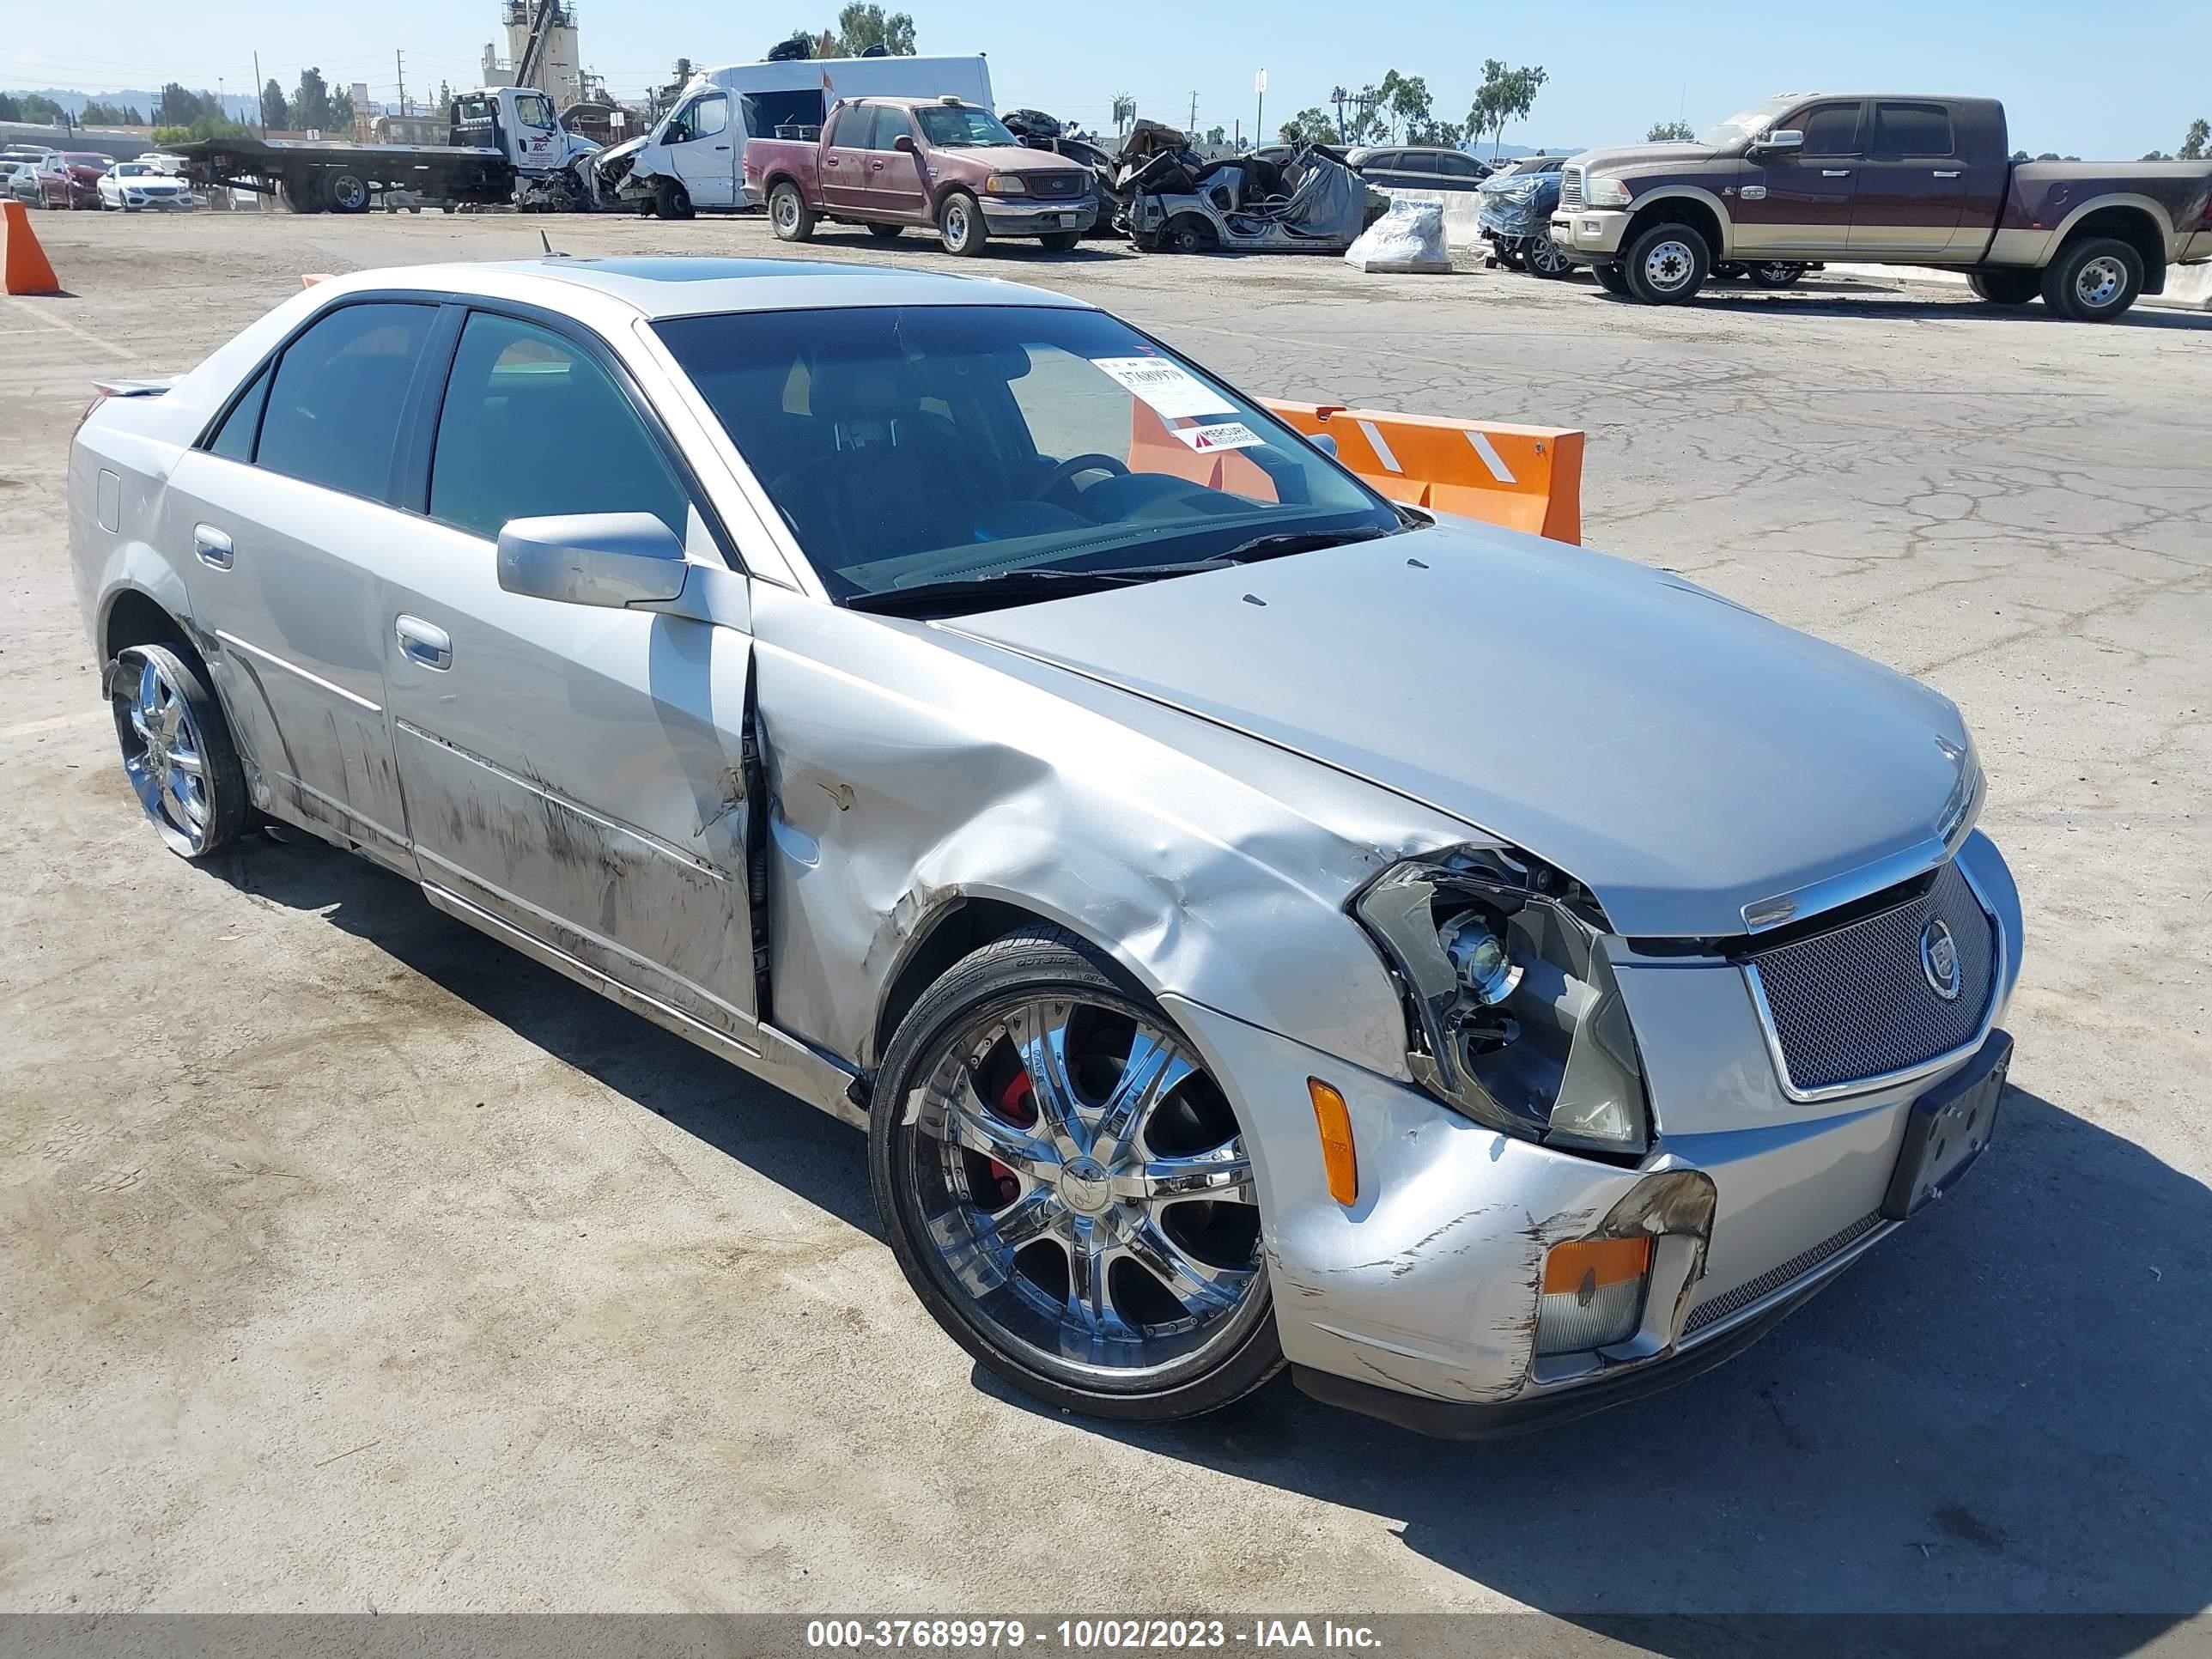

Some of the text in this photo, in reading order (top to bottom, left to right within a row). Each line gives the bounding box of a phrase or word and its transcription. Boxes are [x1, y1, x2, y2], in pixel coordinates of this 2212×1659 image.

[532, 143, 548, 152] RC
[1118, 369, 1184, 384] 37689979
[1200, 426, 1249, 439] MERCURY
[1212, 434, 1259, 446] INSURANCE
